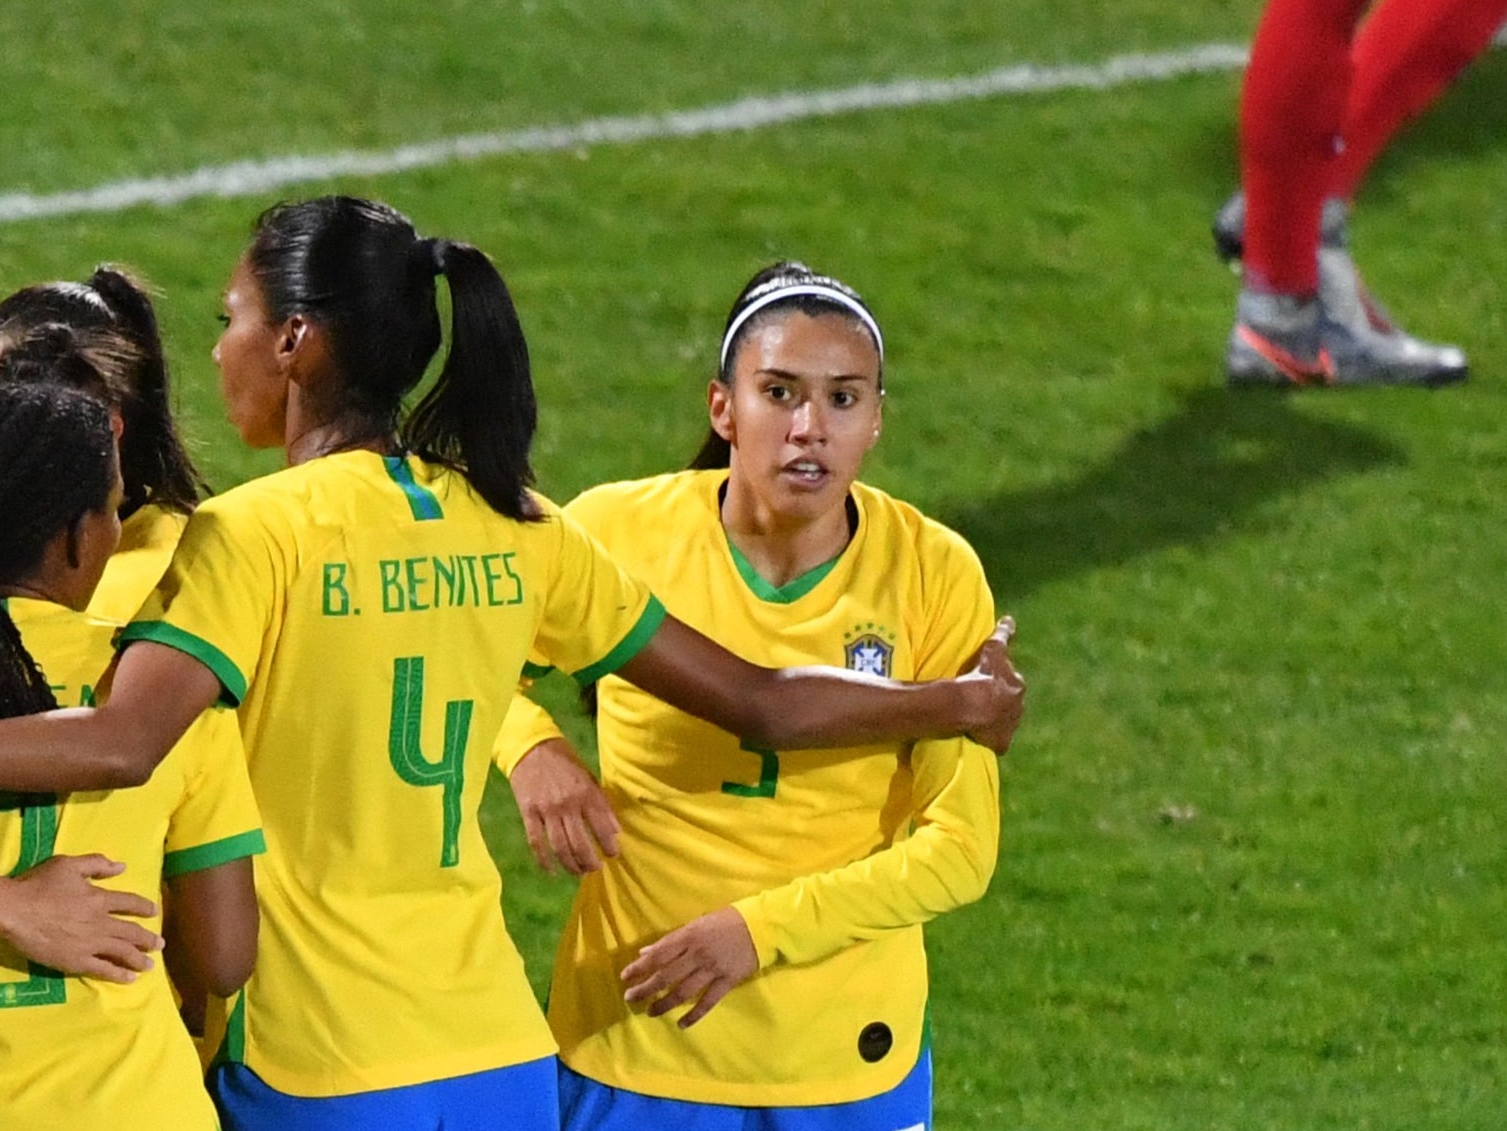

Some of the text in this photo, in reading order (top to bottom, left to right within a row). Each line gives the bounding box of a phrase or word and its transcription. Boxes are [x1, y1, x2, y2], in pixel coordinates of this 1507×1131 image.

[322, 552, 524, 617] B. BENITES
[388, 656, 474, 868] 4
